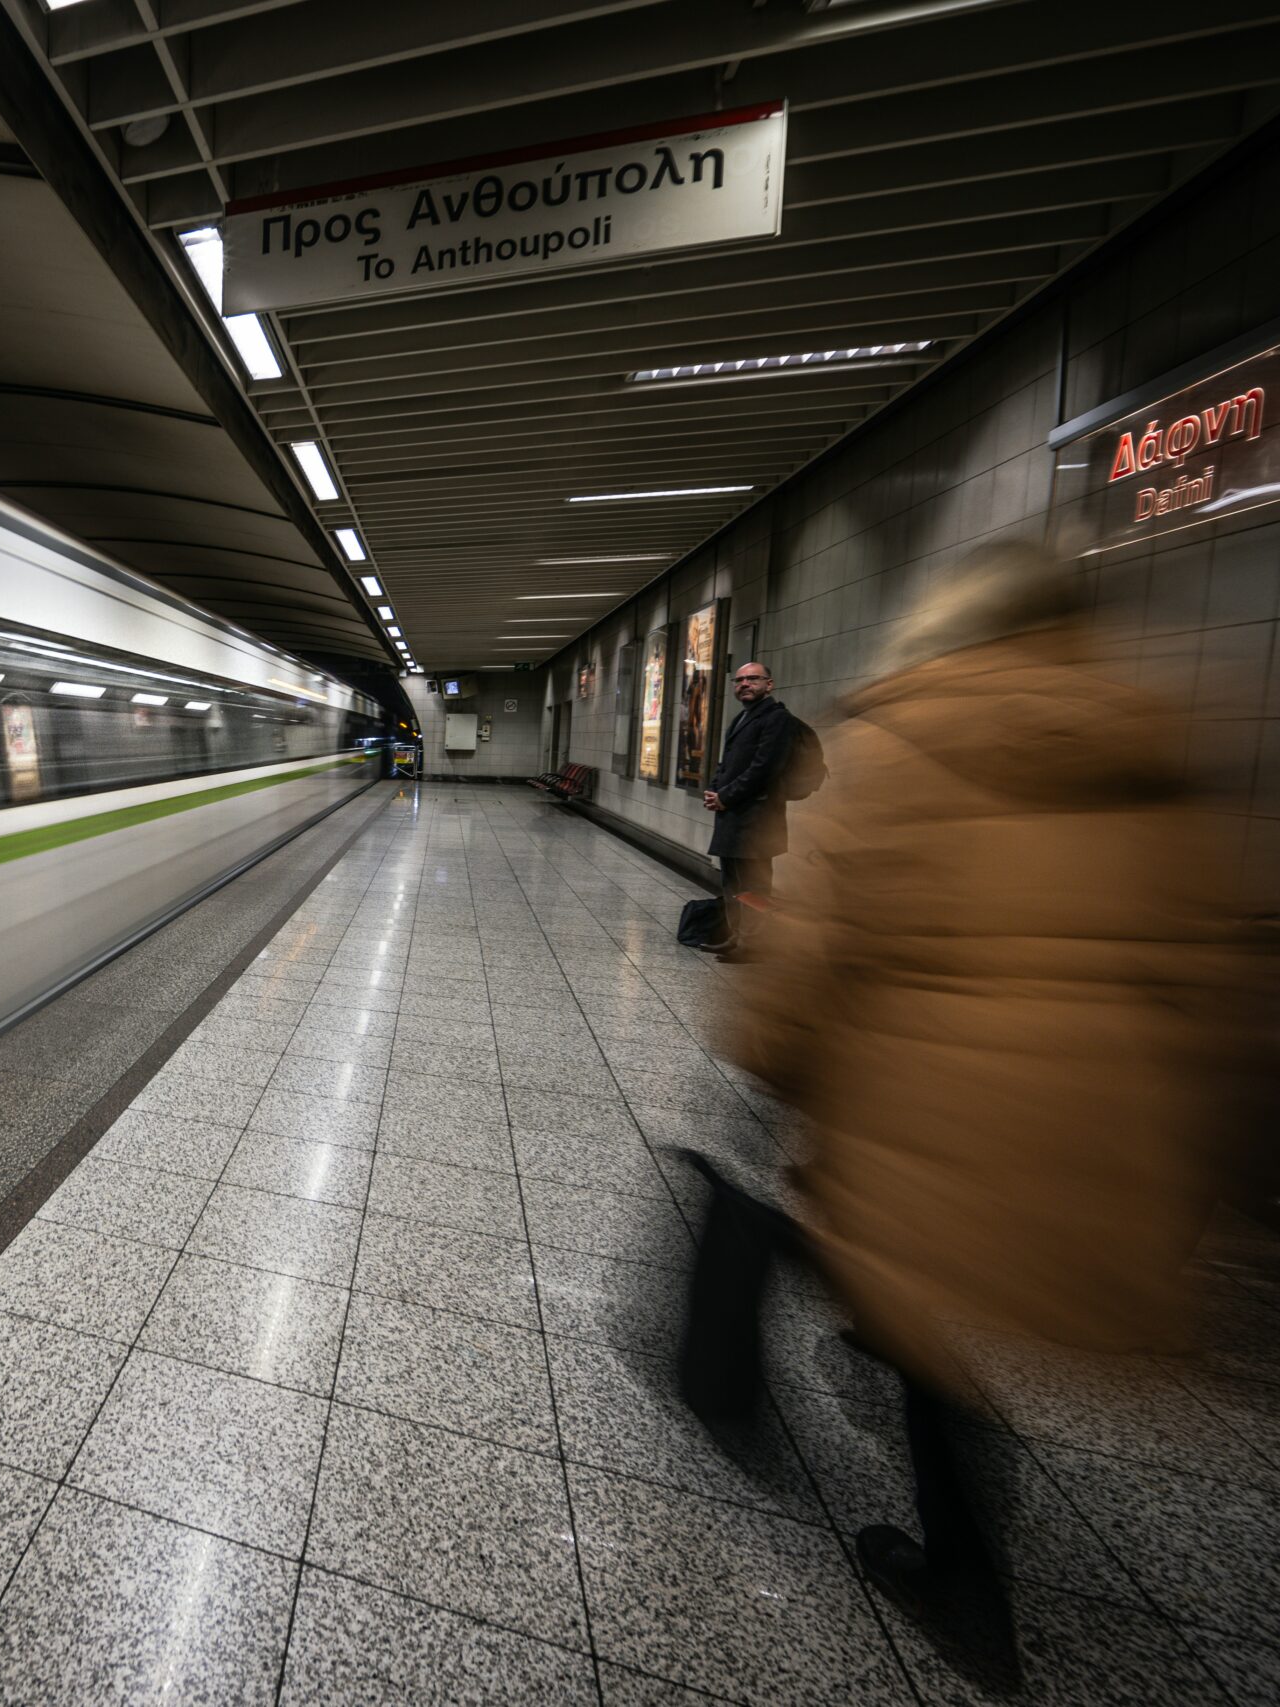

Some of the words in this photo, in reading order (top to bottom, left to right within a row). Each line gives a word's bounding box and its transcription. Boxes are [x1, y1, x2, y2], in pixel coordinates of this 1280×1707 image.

[262, 208, 380, 257] Προς
[407, 147, 724, 229] Ανθούπολη
[358, 253, 394, 281] To
[411, 216, 611, 273] Anthoupoli
[1109, 387, 1264, 483] Δάφνη
[1134, 465, 1214, 522] Dafni
